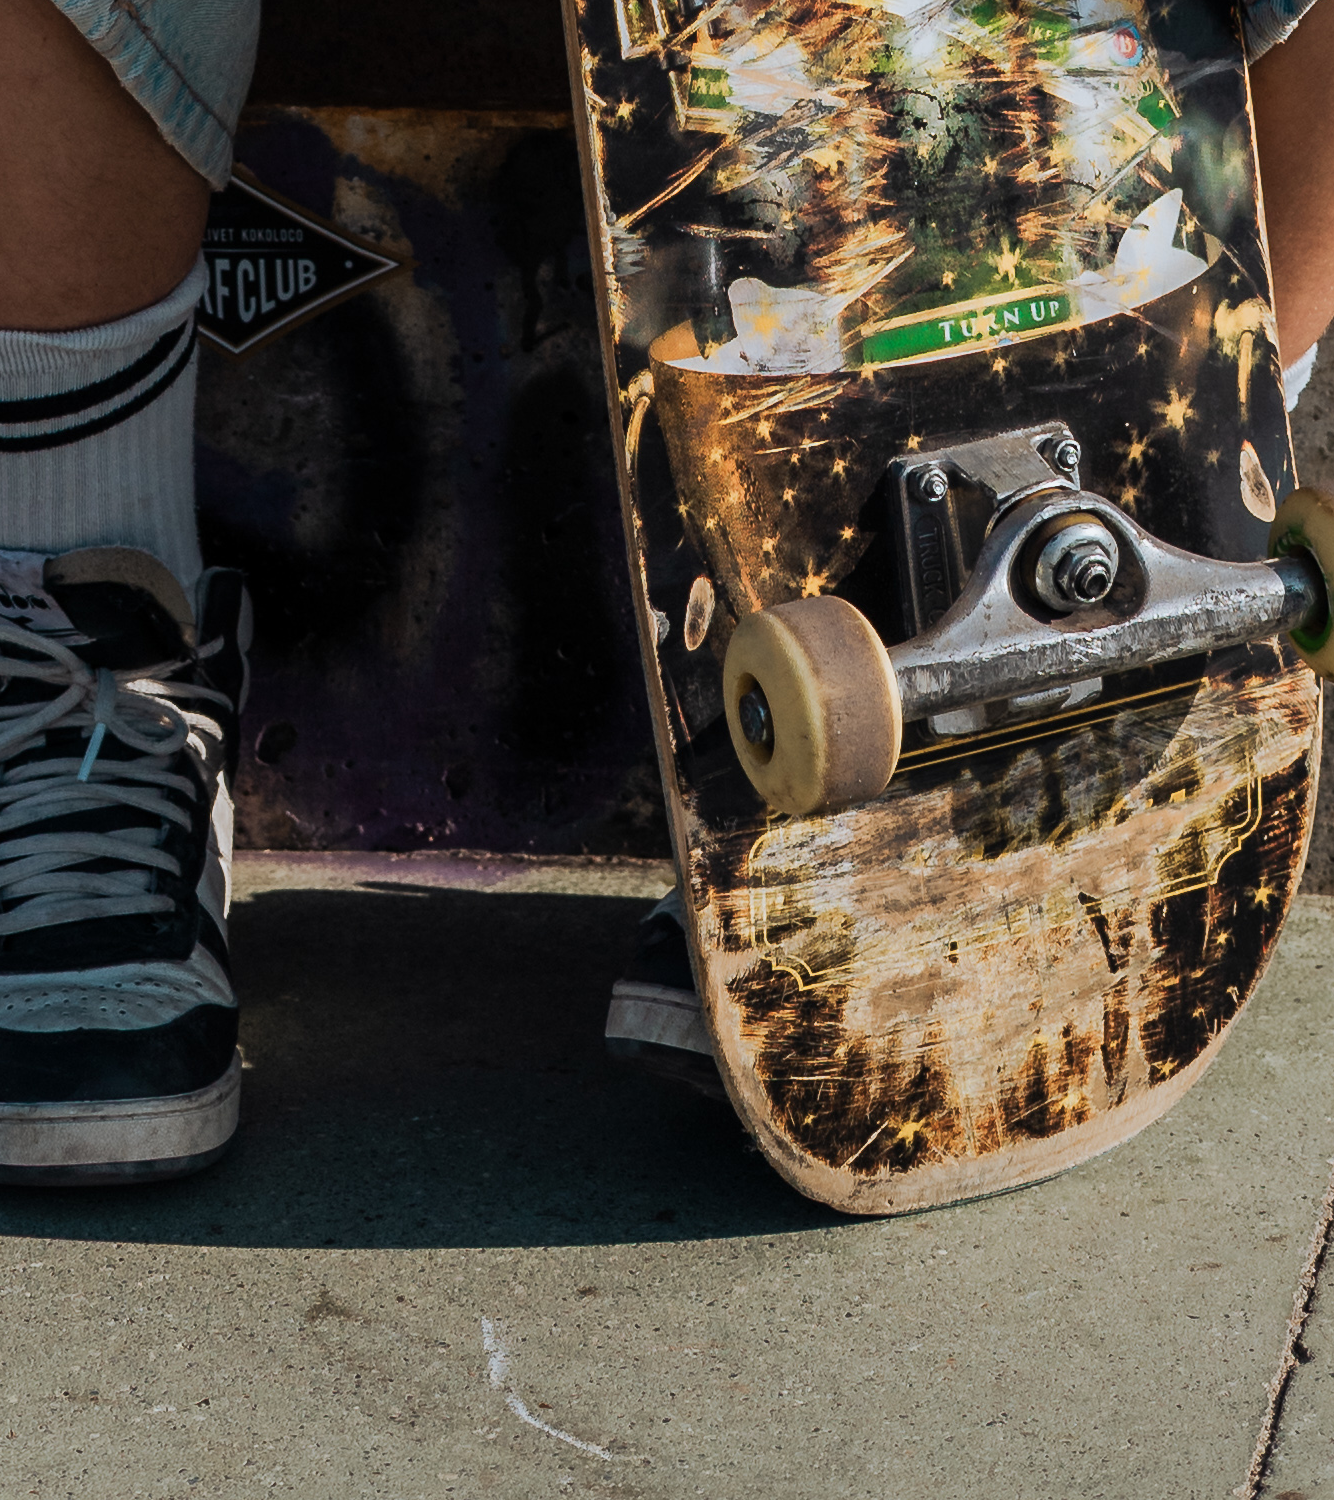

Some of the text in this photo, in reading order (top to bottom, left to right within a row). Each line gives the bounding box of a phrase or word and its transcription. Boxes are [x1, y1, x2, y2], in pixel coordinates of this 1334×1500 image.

[202, 228, 304, 243] IVET KOKOLOCO
[938, 306, 1021, 343] TURN
[918, 526, 946, 598] TRUCK
